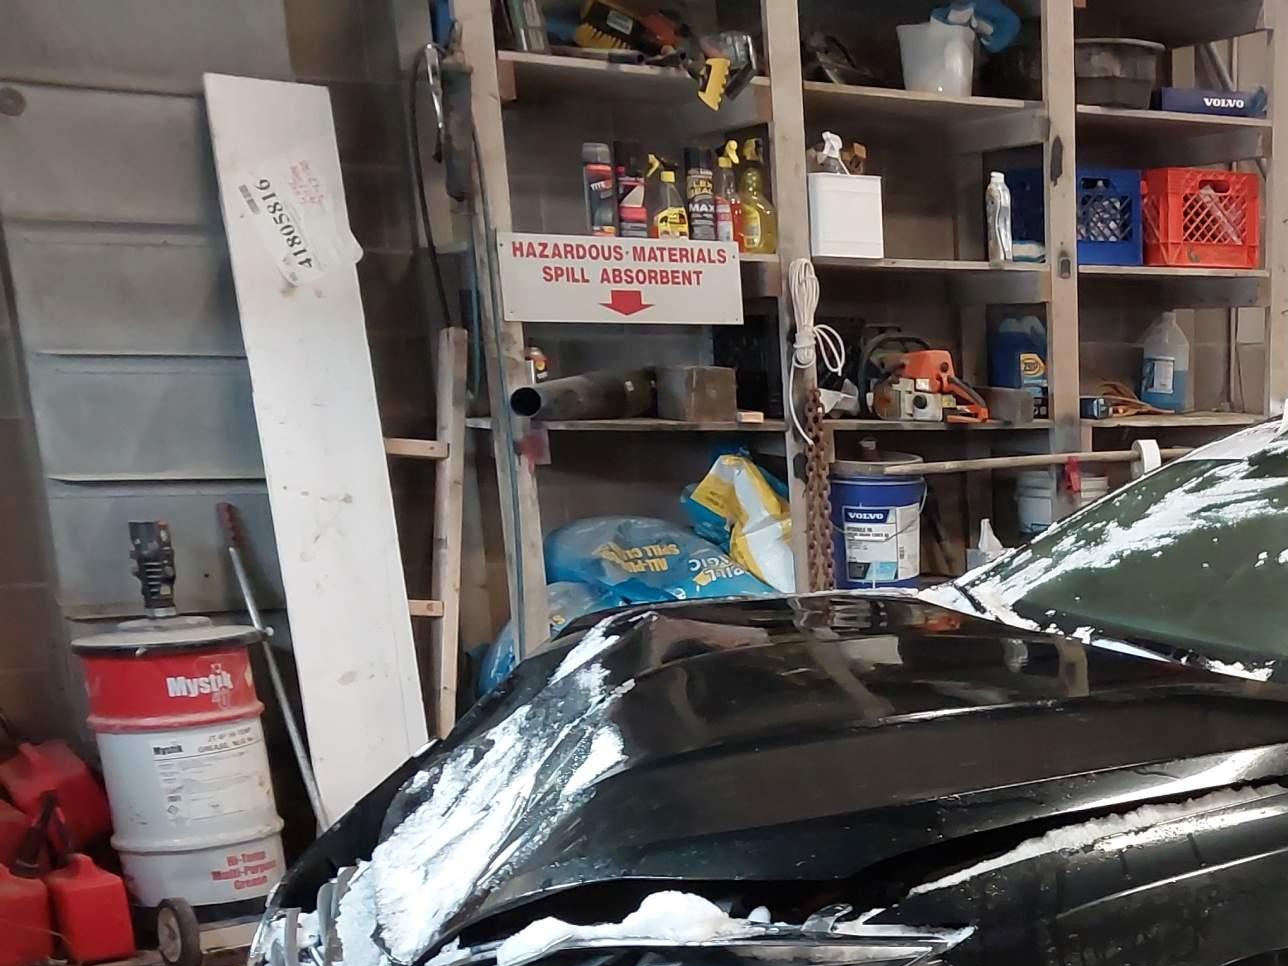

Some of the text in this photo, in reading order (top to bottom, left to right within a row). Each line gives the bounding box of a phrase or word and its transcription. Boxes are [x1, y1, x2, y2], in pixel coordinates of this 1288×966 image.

[1203, 97, 1245, 109] VOLVO
[256, 178, 313, 269] 41805816
[511, 241, 727, 264] HAZARDOUS MATERIALS
[542, 266, 703, 286] SPILL ABSORBENT
[848, 512, 884, 520] VOLVO
[166, 670, 233, 697] Mystik
